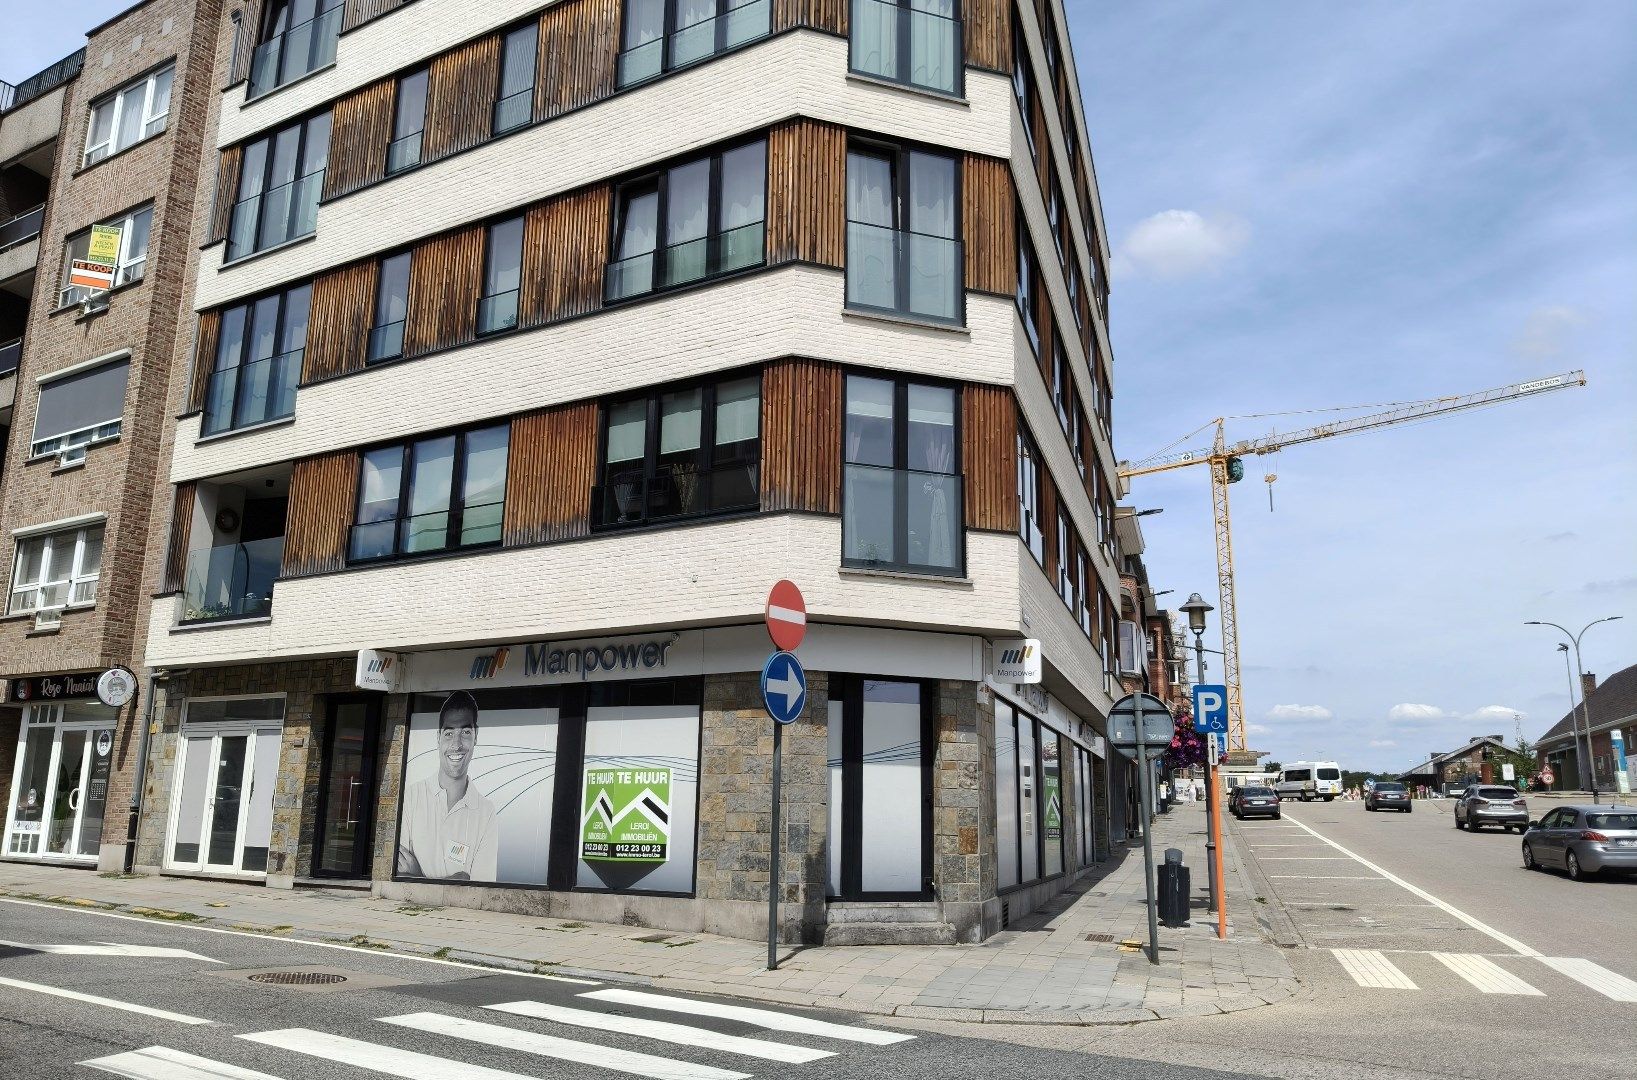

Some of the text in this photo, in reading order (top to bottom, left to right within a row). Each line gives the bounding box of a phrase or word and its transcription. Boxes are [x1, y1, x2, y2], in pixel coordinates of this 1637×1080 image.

[75, 261, 112, 273] TE KOOP
[1197, 691, 1222, 726] P
[588, 772, 614, 785] TE HUUR
[616, 771, 668, 785] TE HUUR
[630, 822, 650, 830] LEROI
[616, 844, 661, 853] 012 23 00 23
